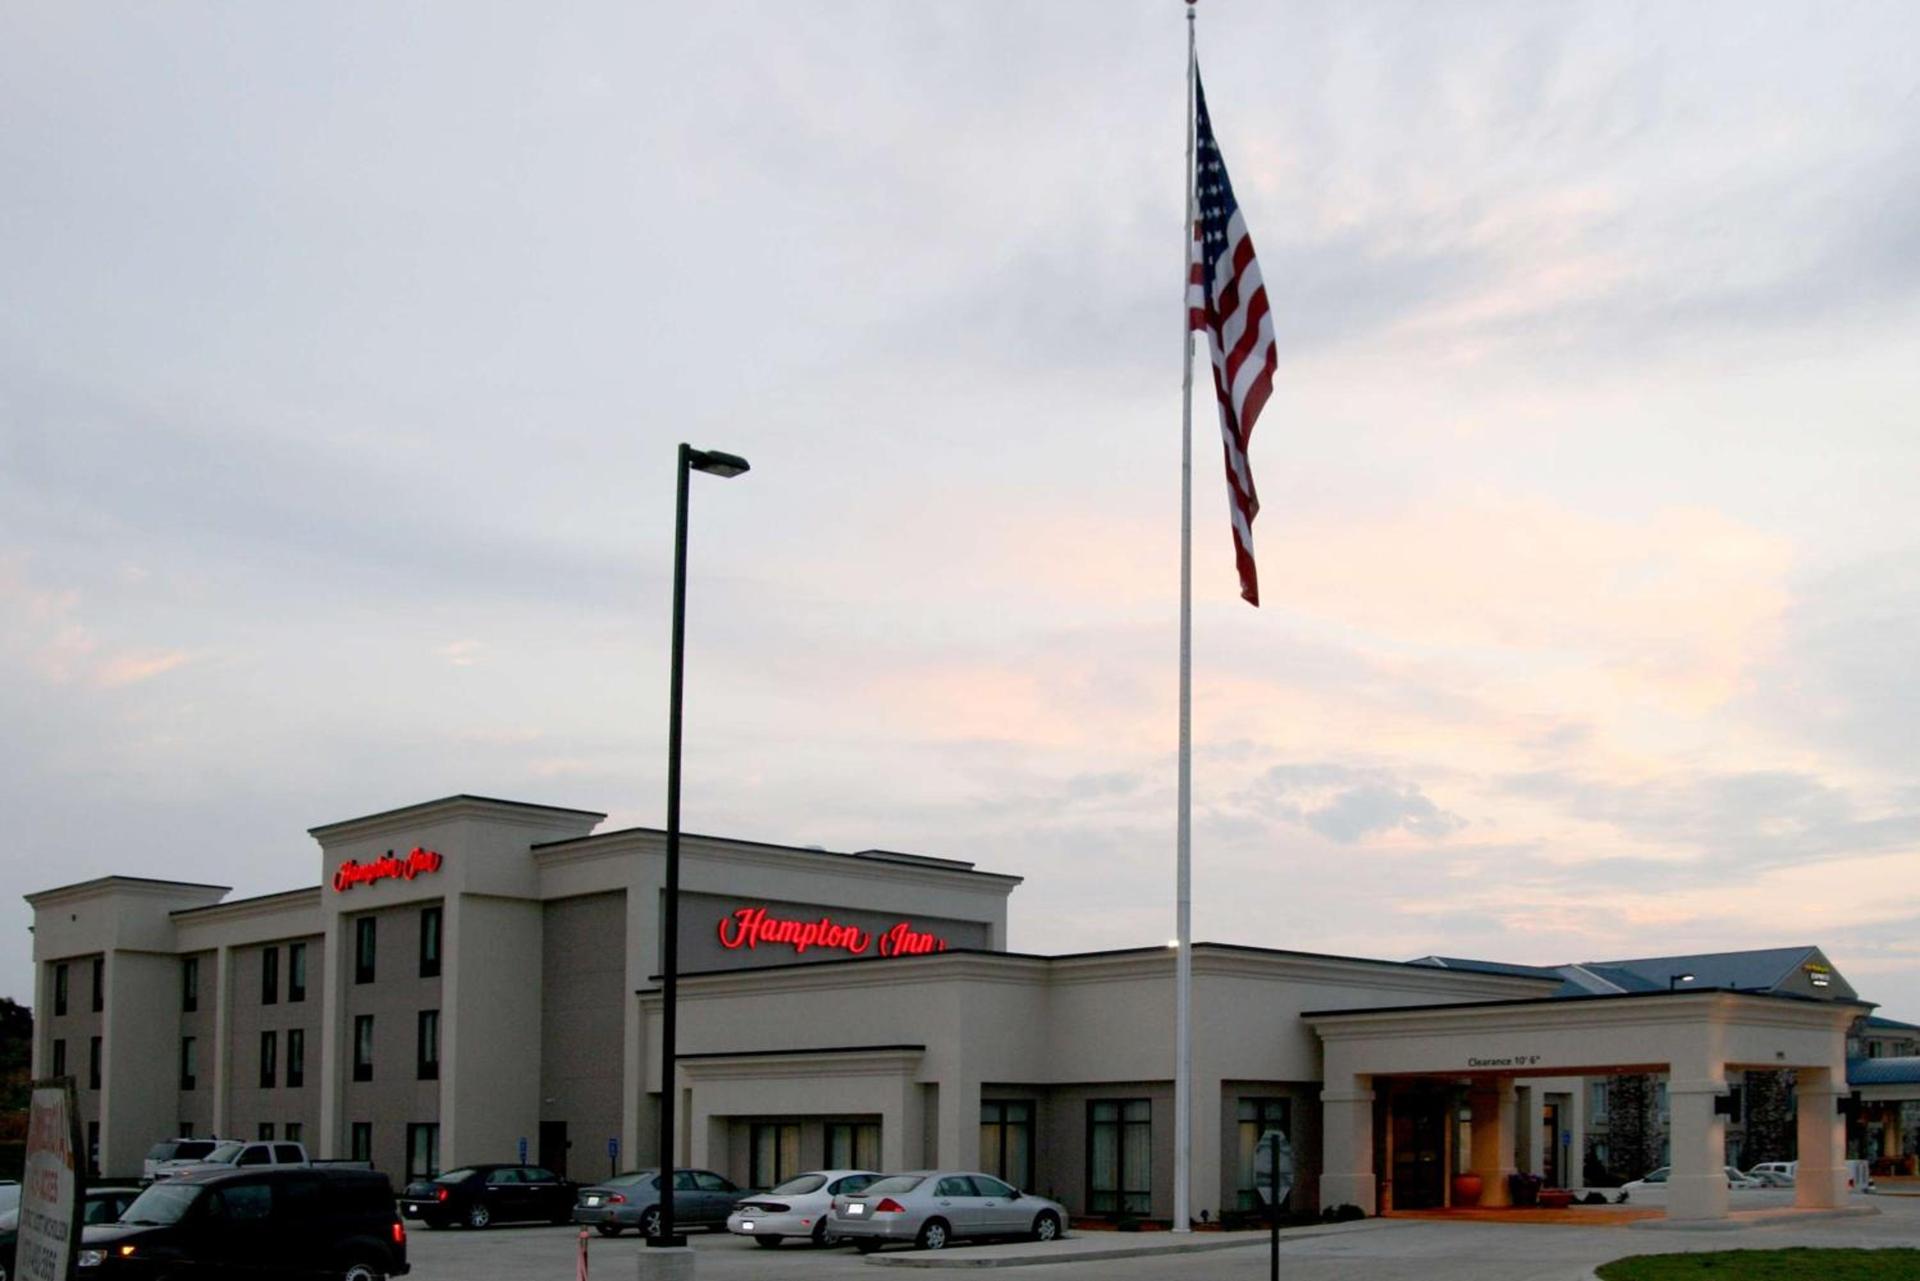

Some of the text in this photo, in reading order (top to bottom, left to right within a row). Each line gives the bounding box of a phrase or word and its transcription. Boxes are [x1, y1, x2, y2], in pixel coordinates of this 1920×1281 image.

[718, 907, 946, 957] Hampton Inn
[1468, 1057, 1512, 1067] Clearance
